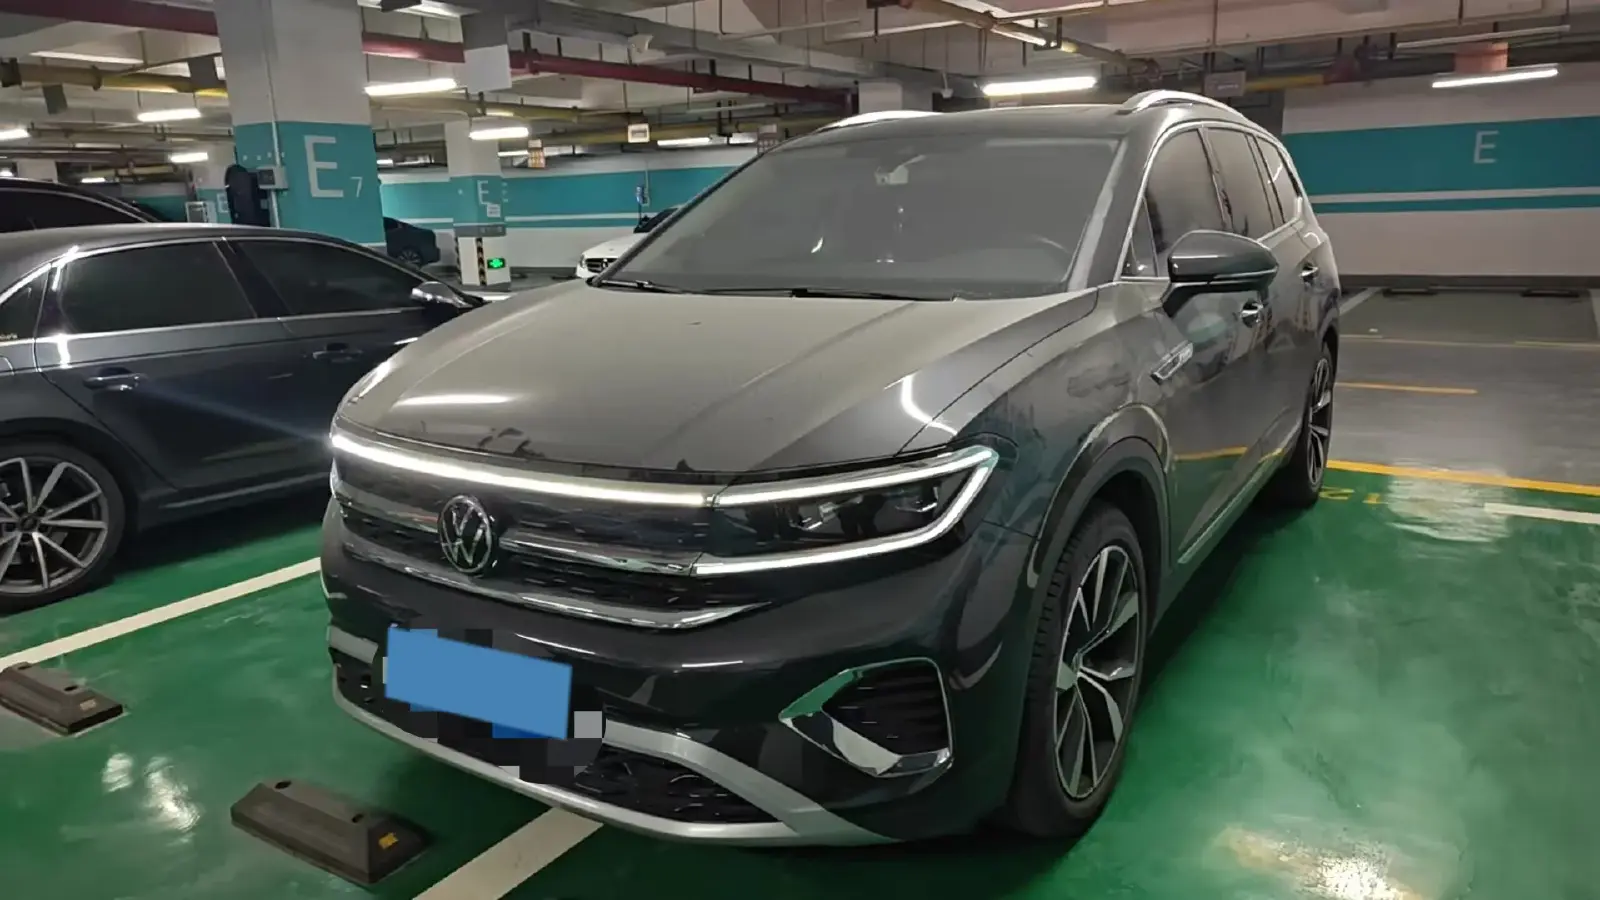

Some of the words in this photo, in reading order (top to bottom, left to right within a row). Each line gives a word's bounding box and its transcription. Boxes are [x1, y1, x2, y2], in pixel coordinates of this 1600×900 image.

[304, 134, 344, 198] E
[350, 176, 362, 198] 7
[1474, 130, 1499, 164] E
